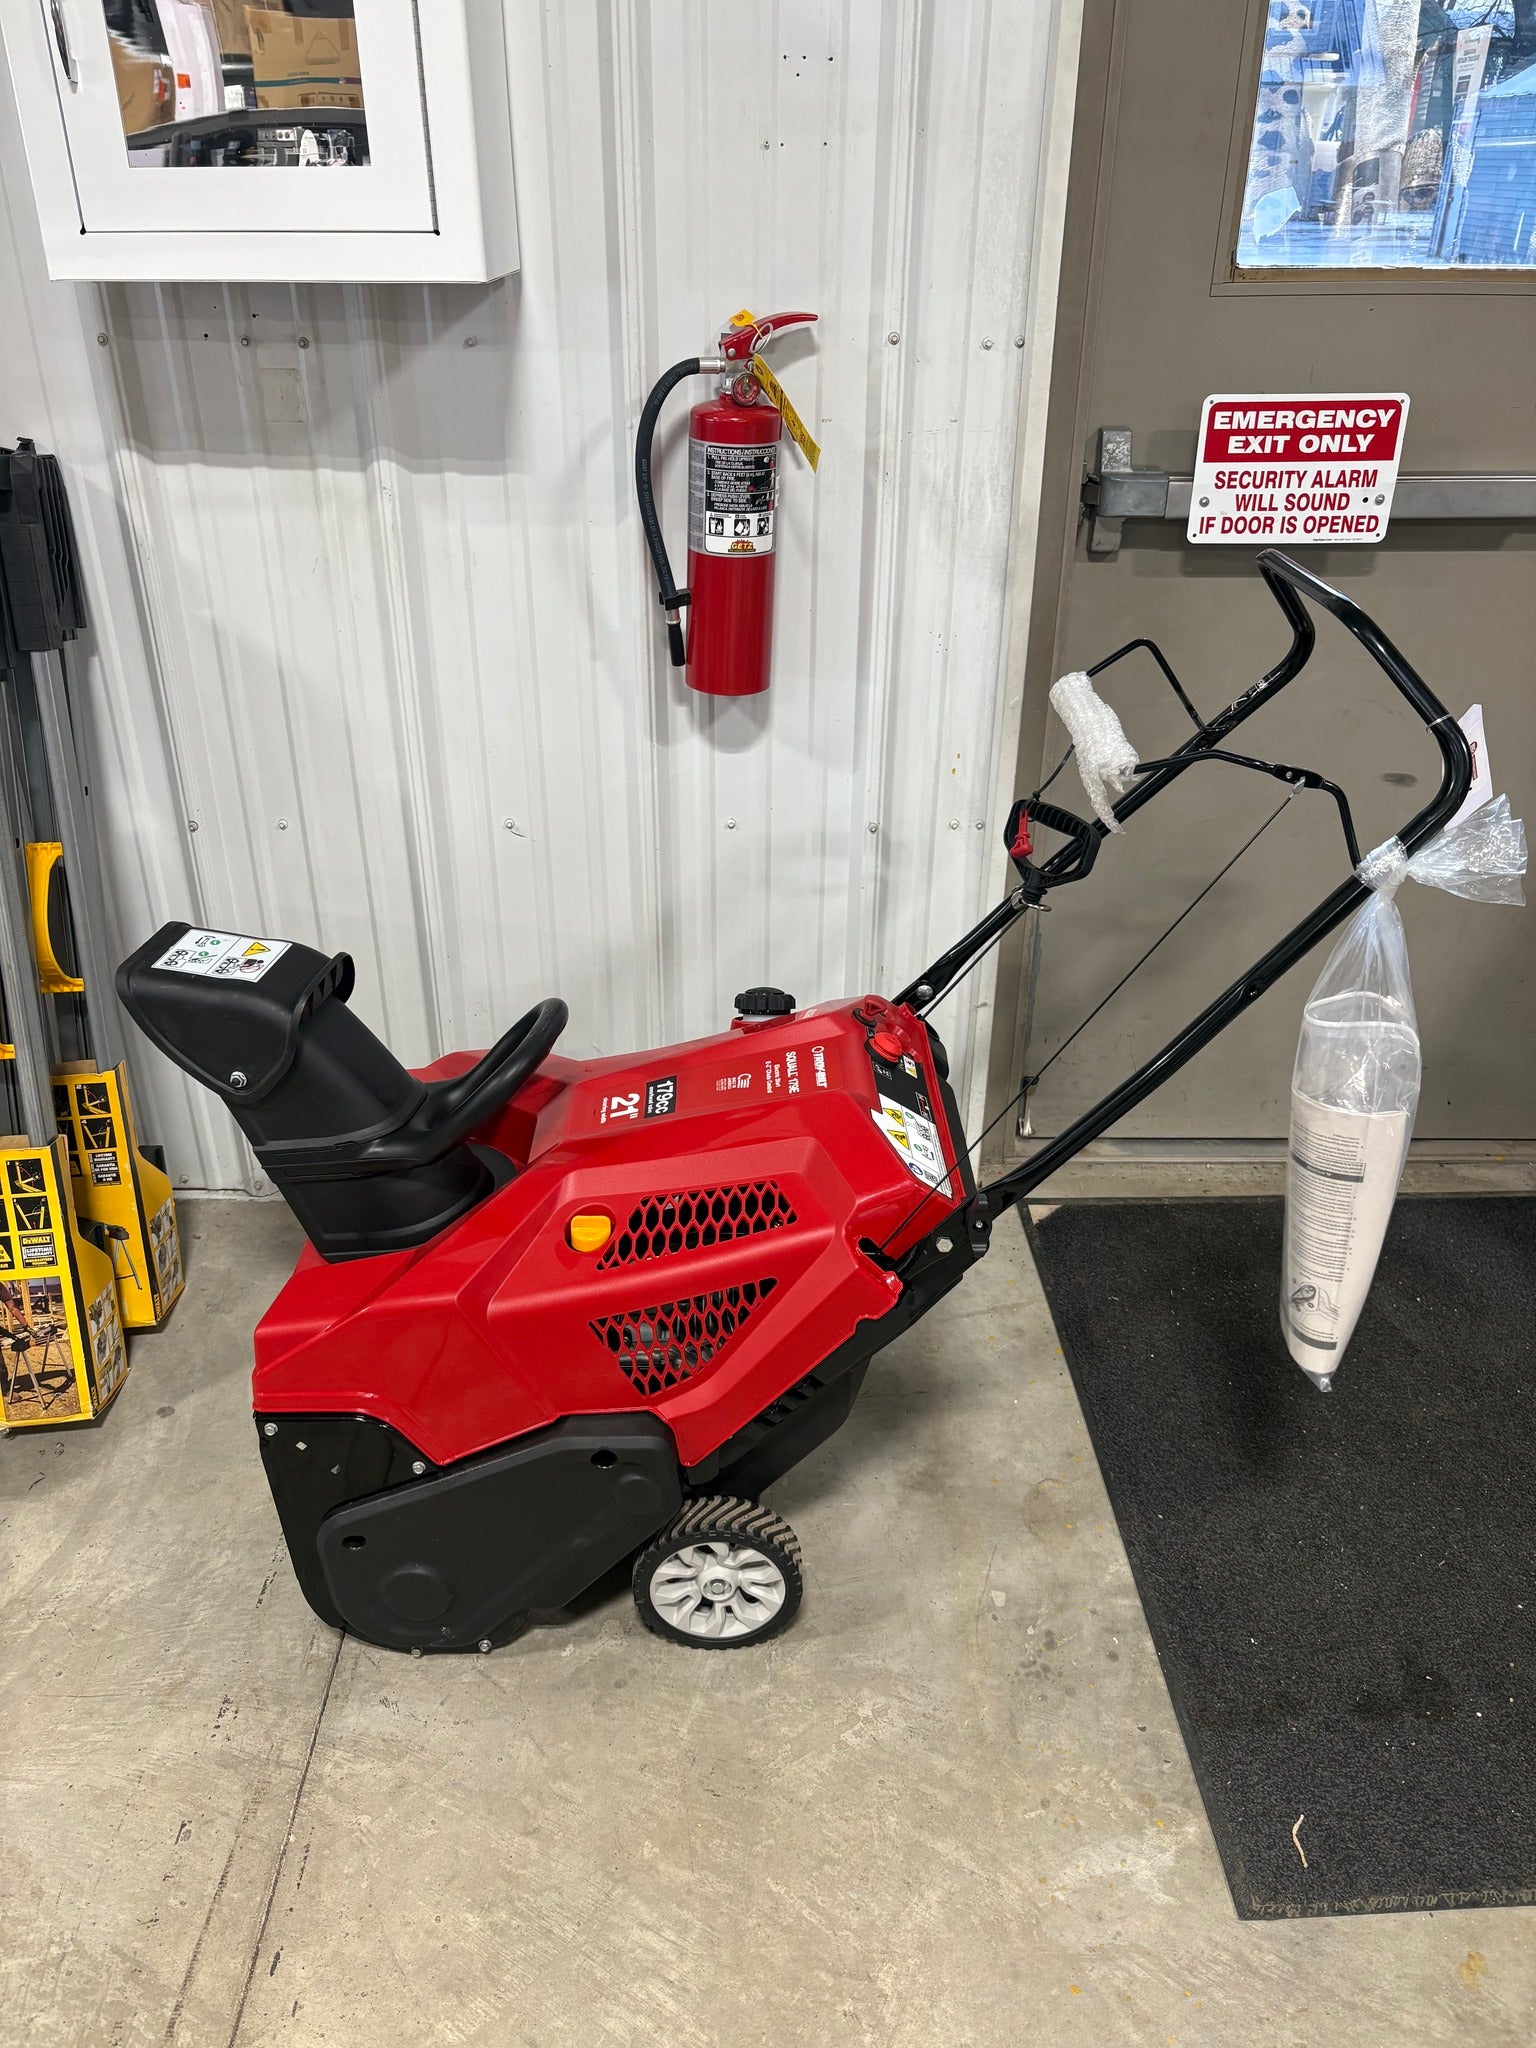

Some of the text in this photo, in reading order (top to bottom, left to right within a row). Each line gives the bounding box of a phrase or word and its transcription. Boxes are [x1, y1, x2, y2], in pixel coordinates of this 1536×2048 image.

[1213, 409, 1396, 430] EMERGENCY
[1227, 433, 1375, 454] EXIT ONLY
[1214, 469, 1379, 489] SECURITY ALARM
[1235, 493, 1351, 512] WILL SOUND
[1199, 515, 1379, 535] IF DOOR IS OPENED
[731, 542, 753, 550] GETZ
[813, 1051, 828, 1089] TROY-BILT
[787, 1077, 800, 1094] 179E
[655, 1080, 674, 1115] 179cc
